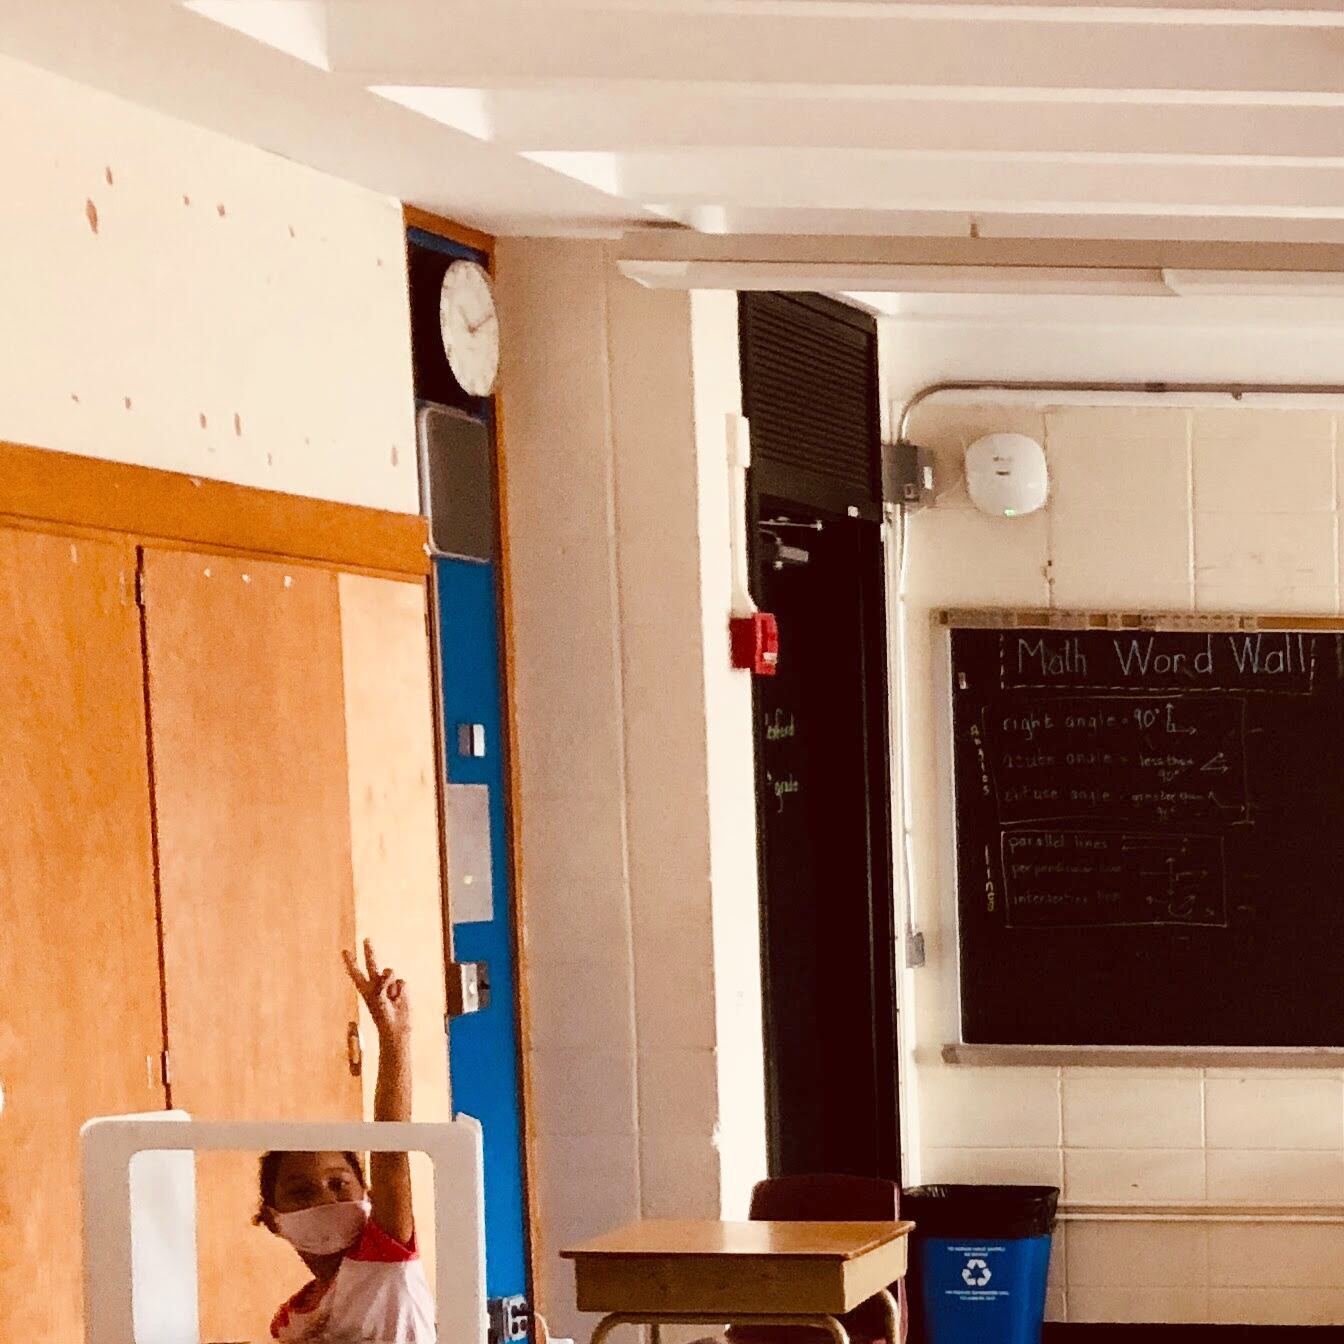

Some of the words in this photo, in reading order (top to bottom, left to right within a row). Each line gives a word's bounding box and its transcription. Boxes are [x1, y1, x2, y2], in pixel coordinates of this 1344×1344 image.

[1018, 637, 1087, 676] Math
[1114, 634, 1212, 677] Word
[1229, 633, 1306, 674] Wall
[1003, 712, 1054, 740] right
[1065, 710, 1117, 735] angle
